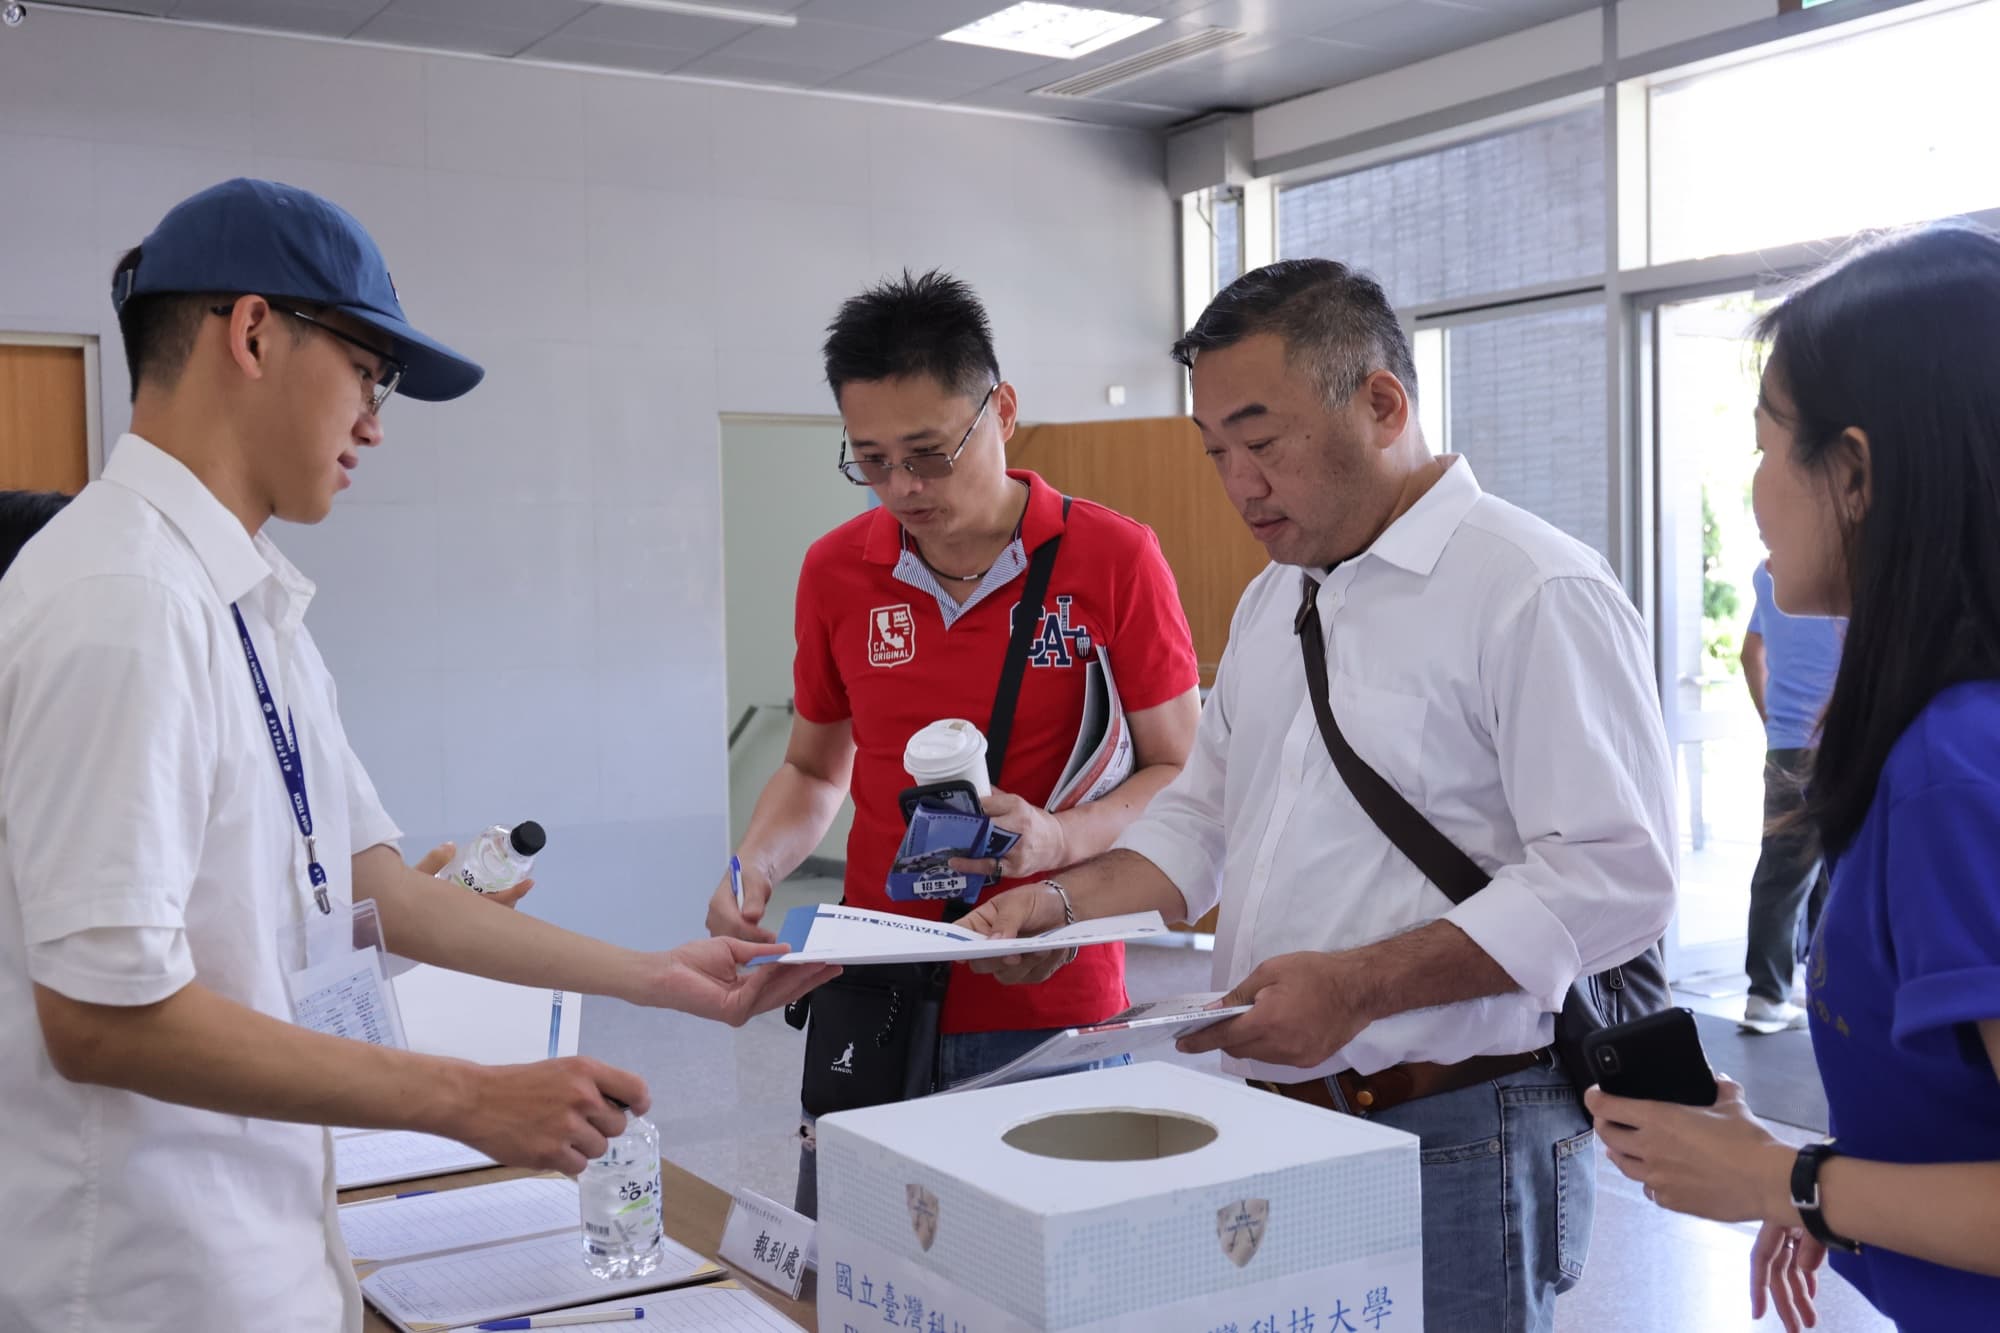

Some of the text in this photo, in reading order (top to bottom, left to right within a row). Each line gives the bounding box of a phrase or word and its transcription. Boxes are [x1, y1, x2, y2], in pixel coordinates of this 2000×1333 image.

[873, 648, 910, 662] ORIGINAL
[752, 1230, 800, 1280] 報到處
[1207, 1285, 1394, 1333] 技大學
